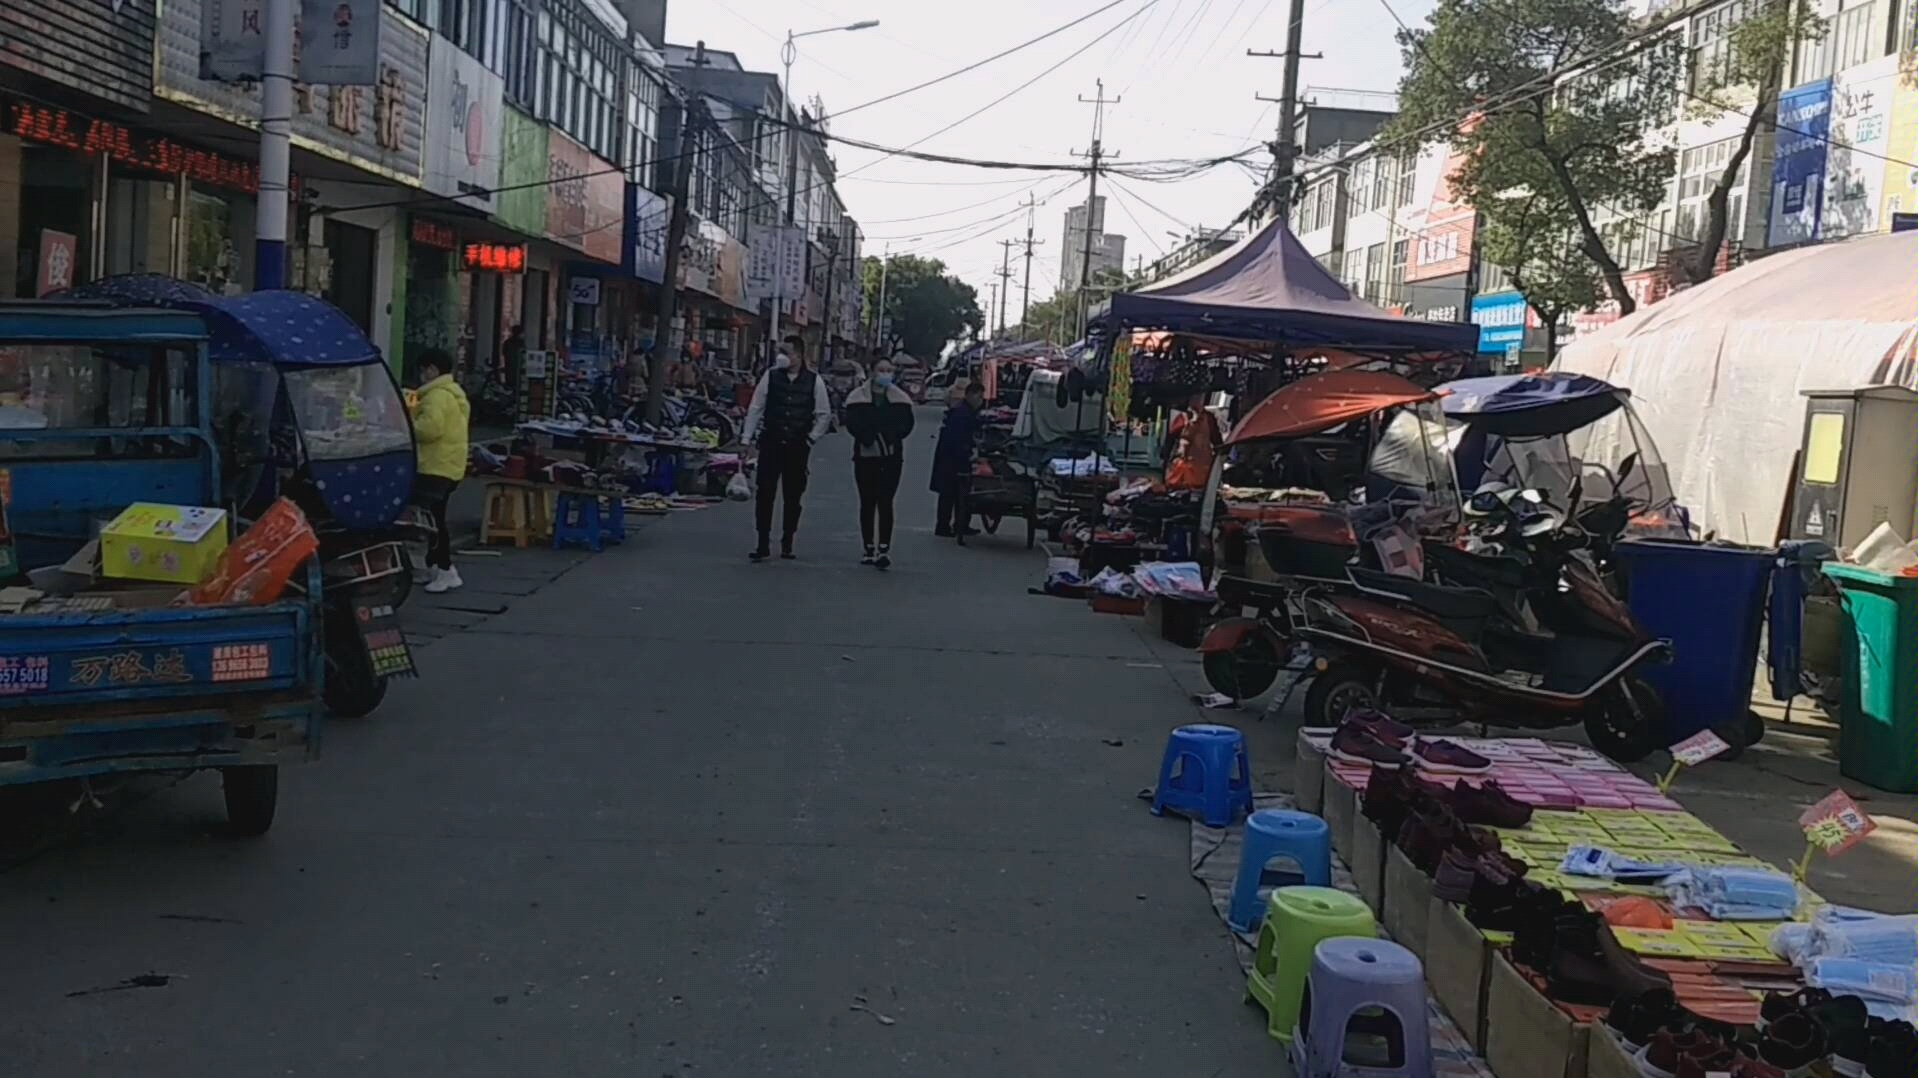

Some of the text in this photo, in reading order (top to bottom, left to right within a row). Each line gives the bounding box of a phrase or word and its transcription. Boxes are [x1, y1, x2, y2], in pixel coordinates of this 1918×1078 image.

[573, 284, 590, 299] 5G
[70, 649, 193, 684] 万路达
[19, 667, 49, 682] 5018
